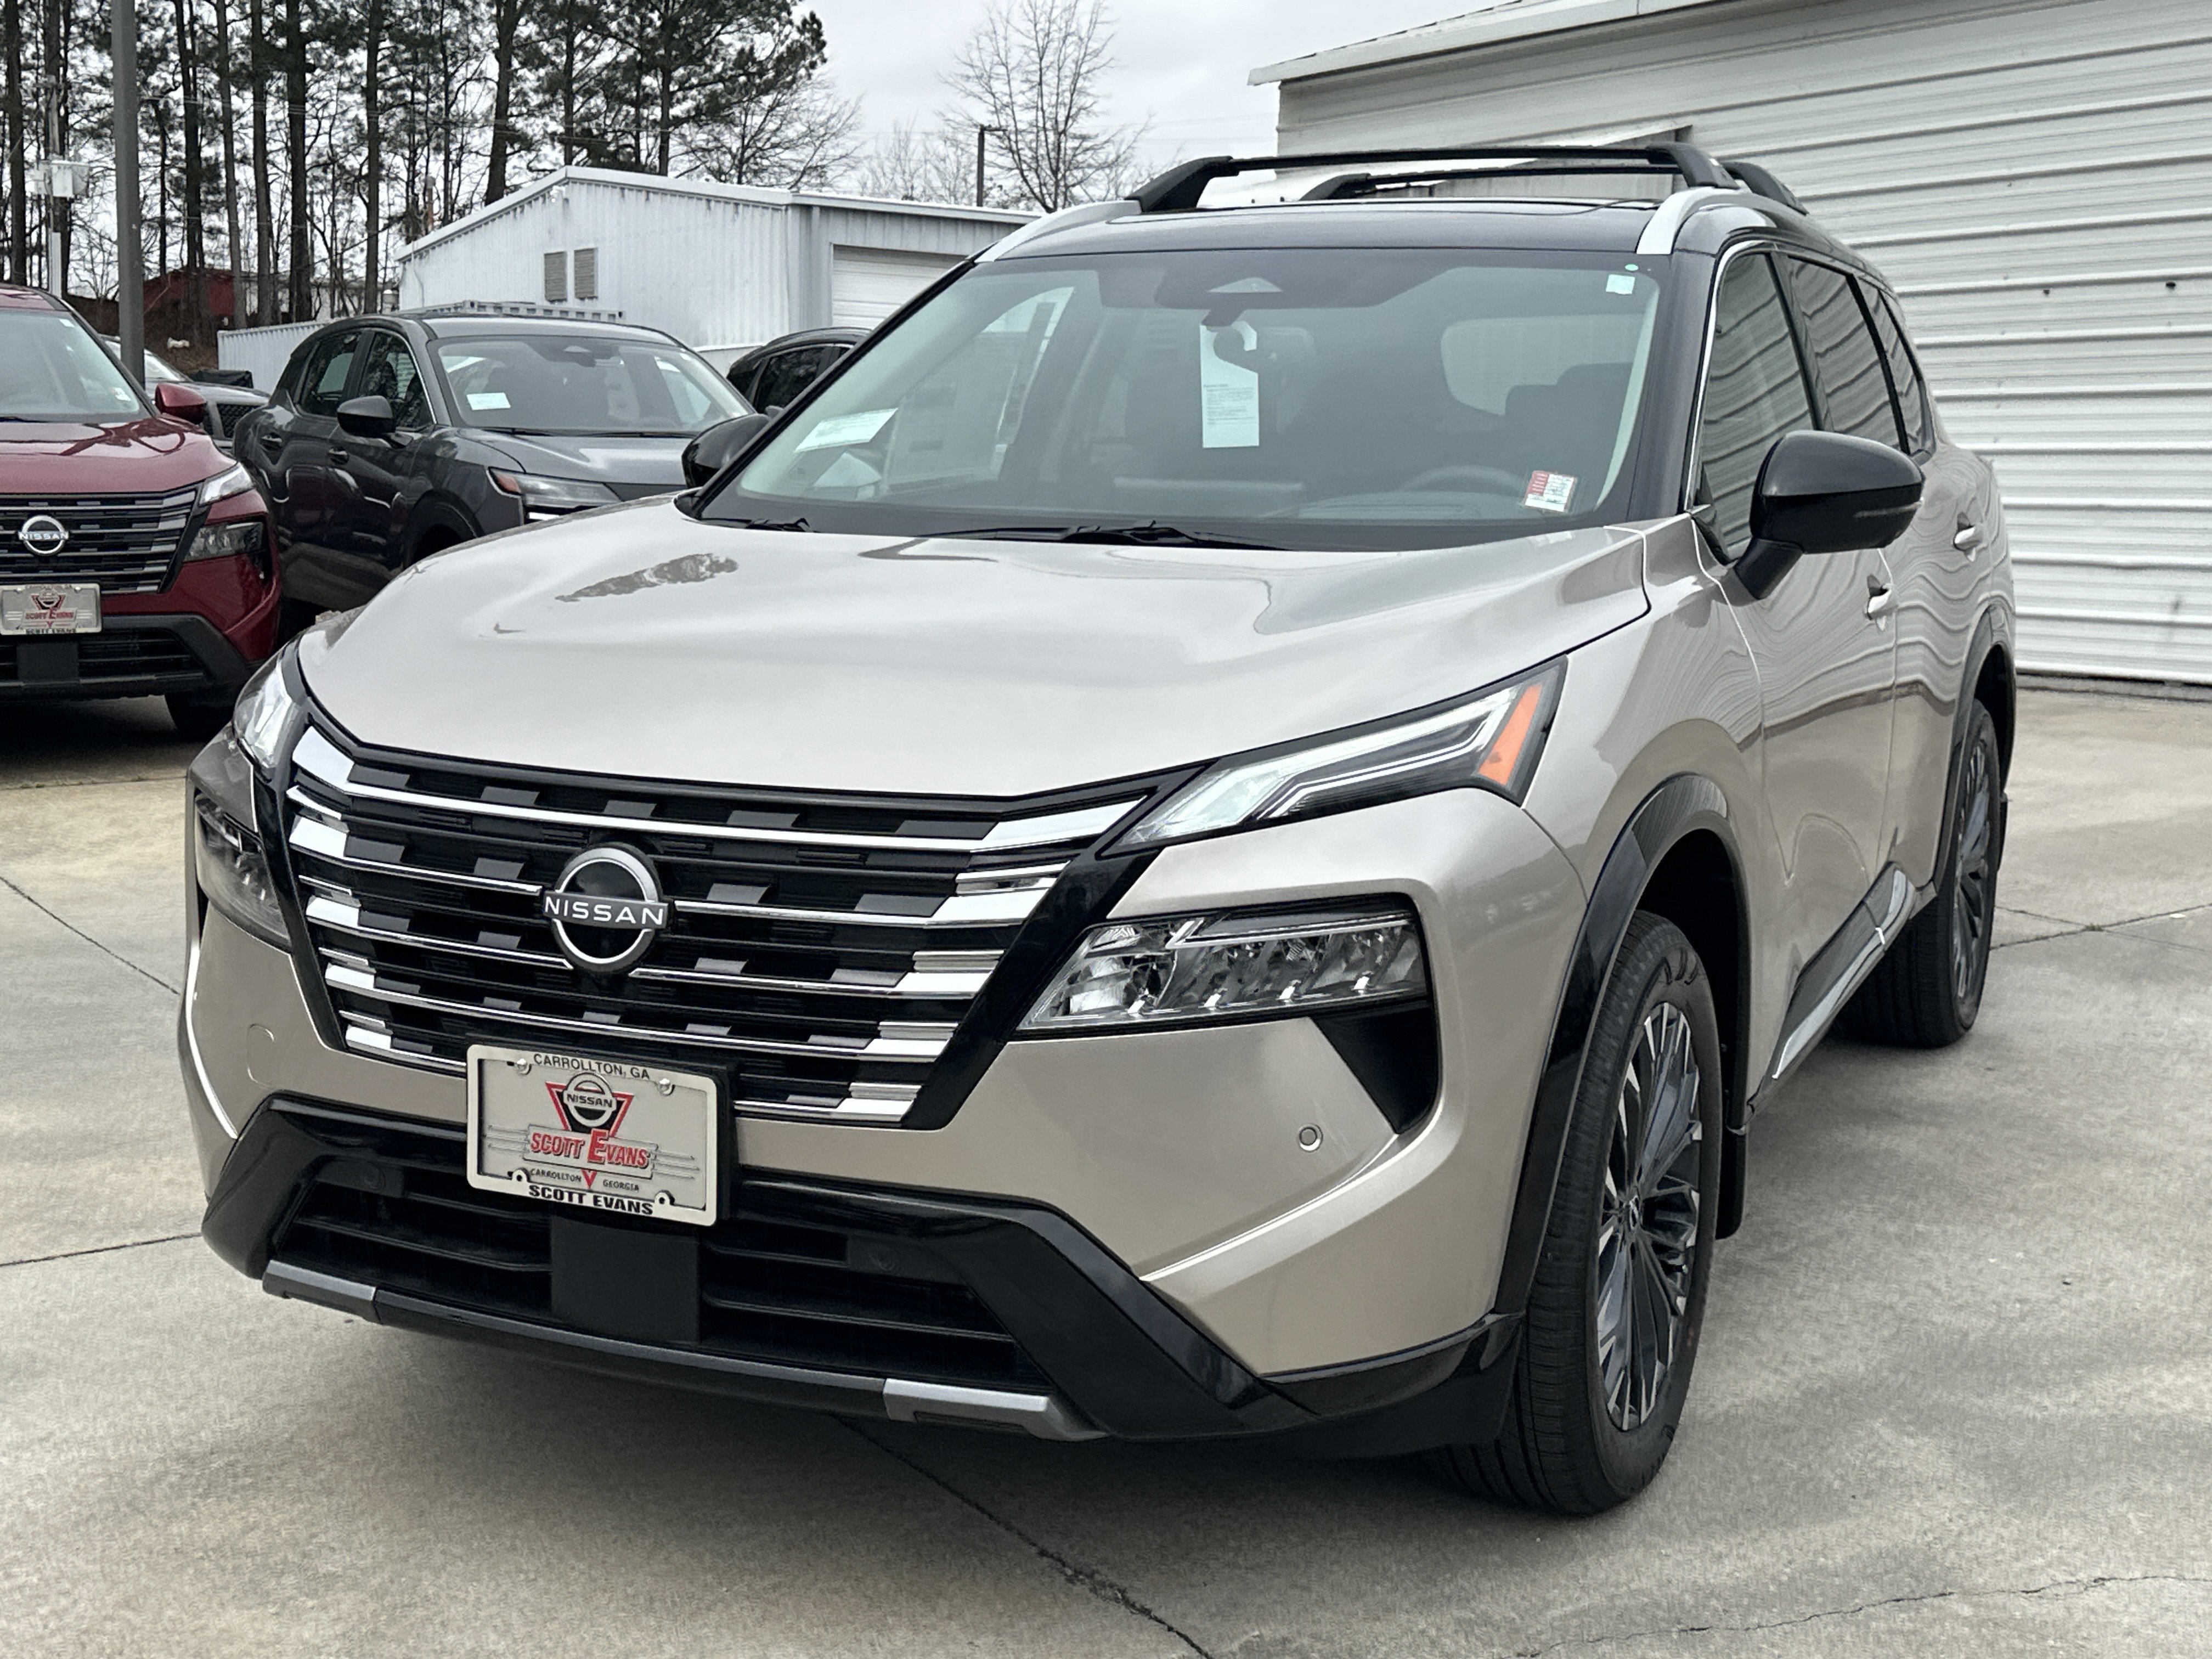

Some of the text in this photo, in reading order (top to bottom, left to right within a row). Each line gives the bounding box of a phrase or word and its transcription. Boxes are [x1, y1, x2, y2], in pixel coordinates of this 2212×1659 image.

[544, 896, 663, 926] NISSAN
[533, 1053, 651, 1080] CARROLLTON, GA
[567, 1093, 613, 1108] NISSAN
[530, 1128, 651, 1169] SCOTT EVANS
[530, 1168, 640, 1192] CARROLLTON GEORGIA
[528, 1184, 653, 1215] SCOTT EVANS
